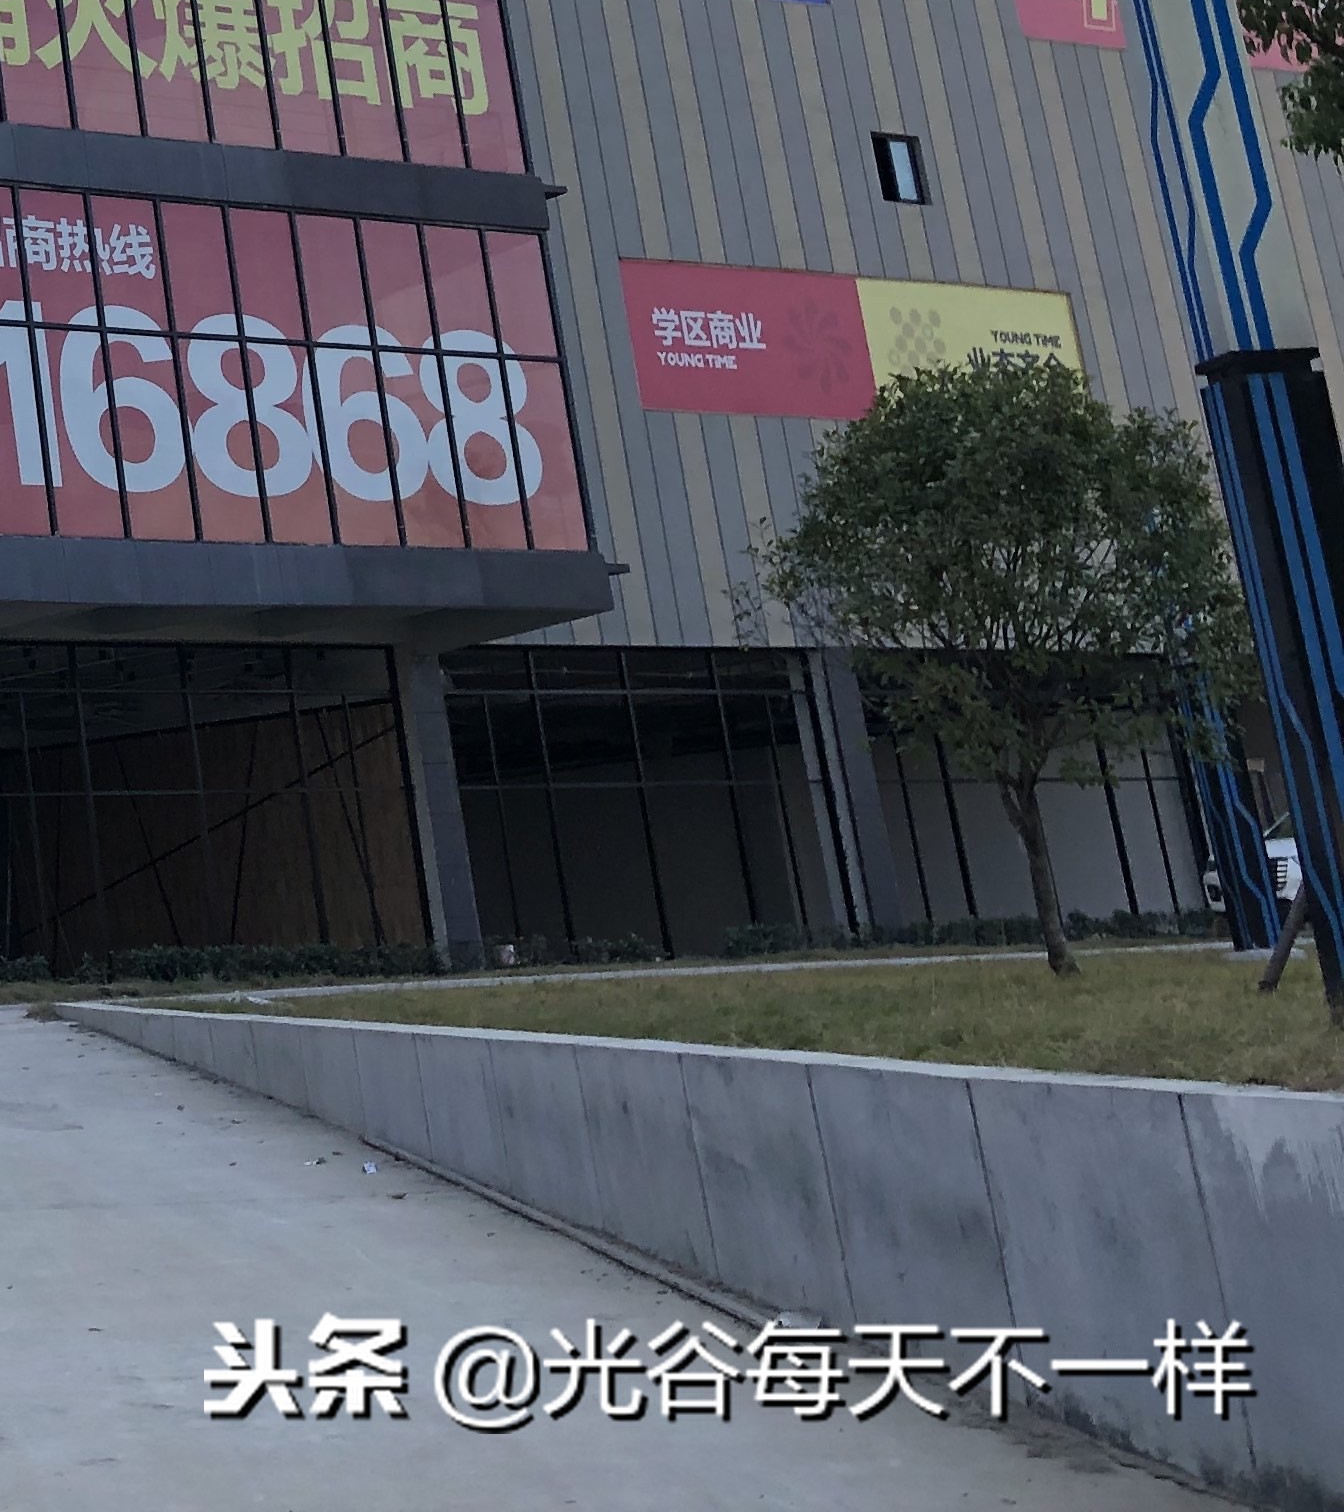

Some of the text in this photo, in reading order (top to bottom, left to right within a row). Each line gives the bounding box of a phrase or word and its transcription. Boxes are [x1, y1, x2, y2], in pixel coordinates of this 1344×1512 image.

[652, 307, 767, 349] 学区商业
[989, 329, 1062, 349] YOUNG TIME
[656, 351, 738, 370] YOUNG TIME
